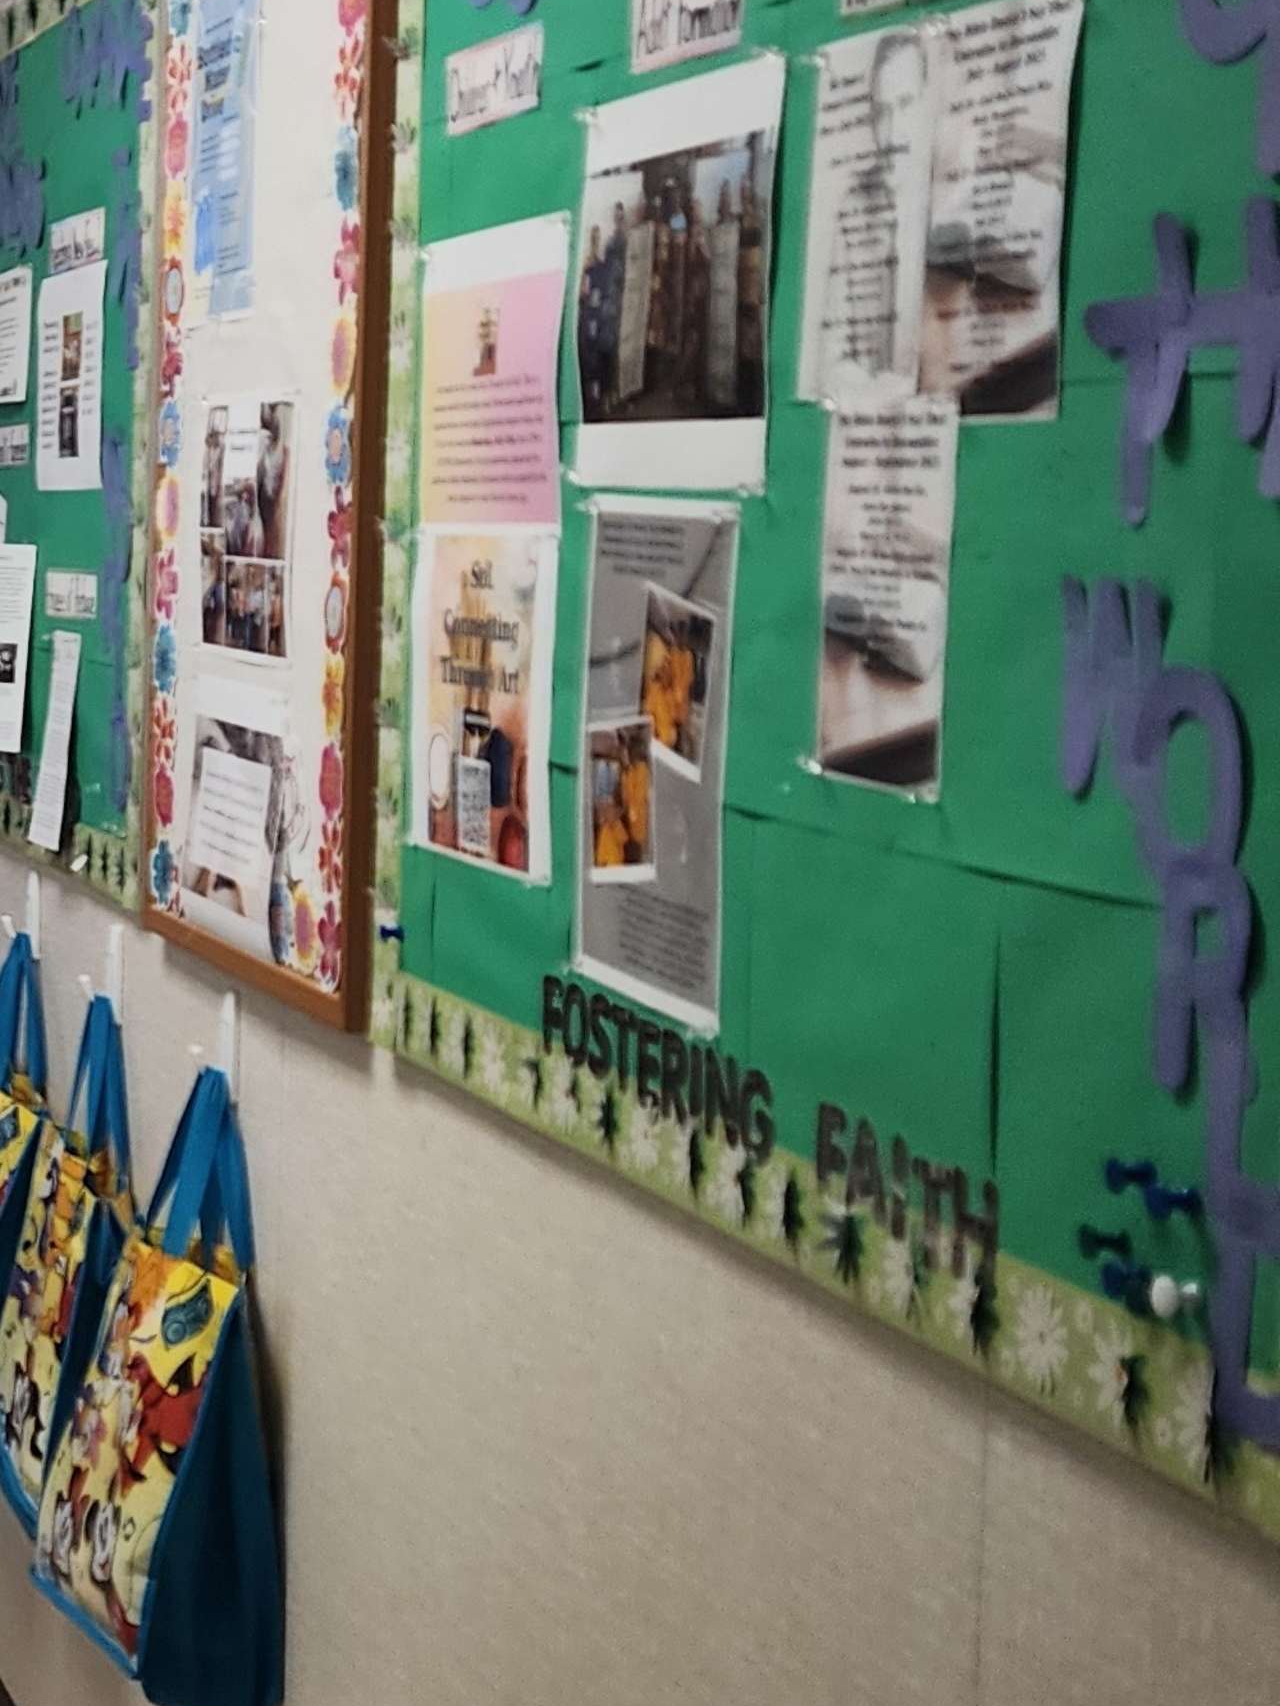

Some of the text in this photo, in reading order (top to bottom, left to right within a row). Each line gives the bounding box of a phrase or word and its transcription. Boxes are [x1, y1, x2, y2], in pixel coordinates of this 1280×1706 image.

[498, 665, 519, 694] Art
[542, 974, 999, 1285] FOSTERING FAITH
